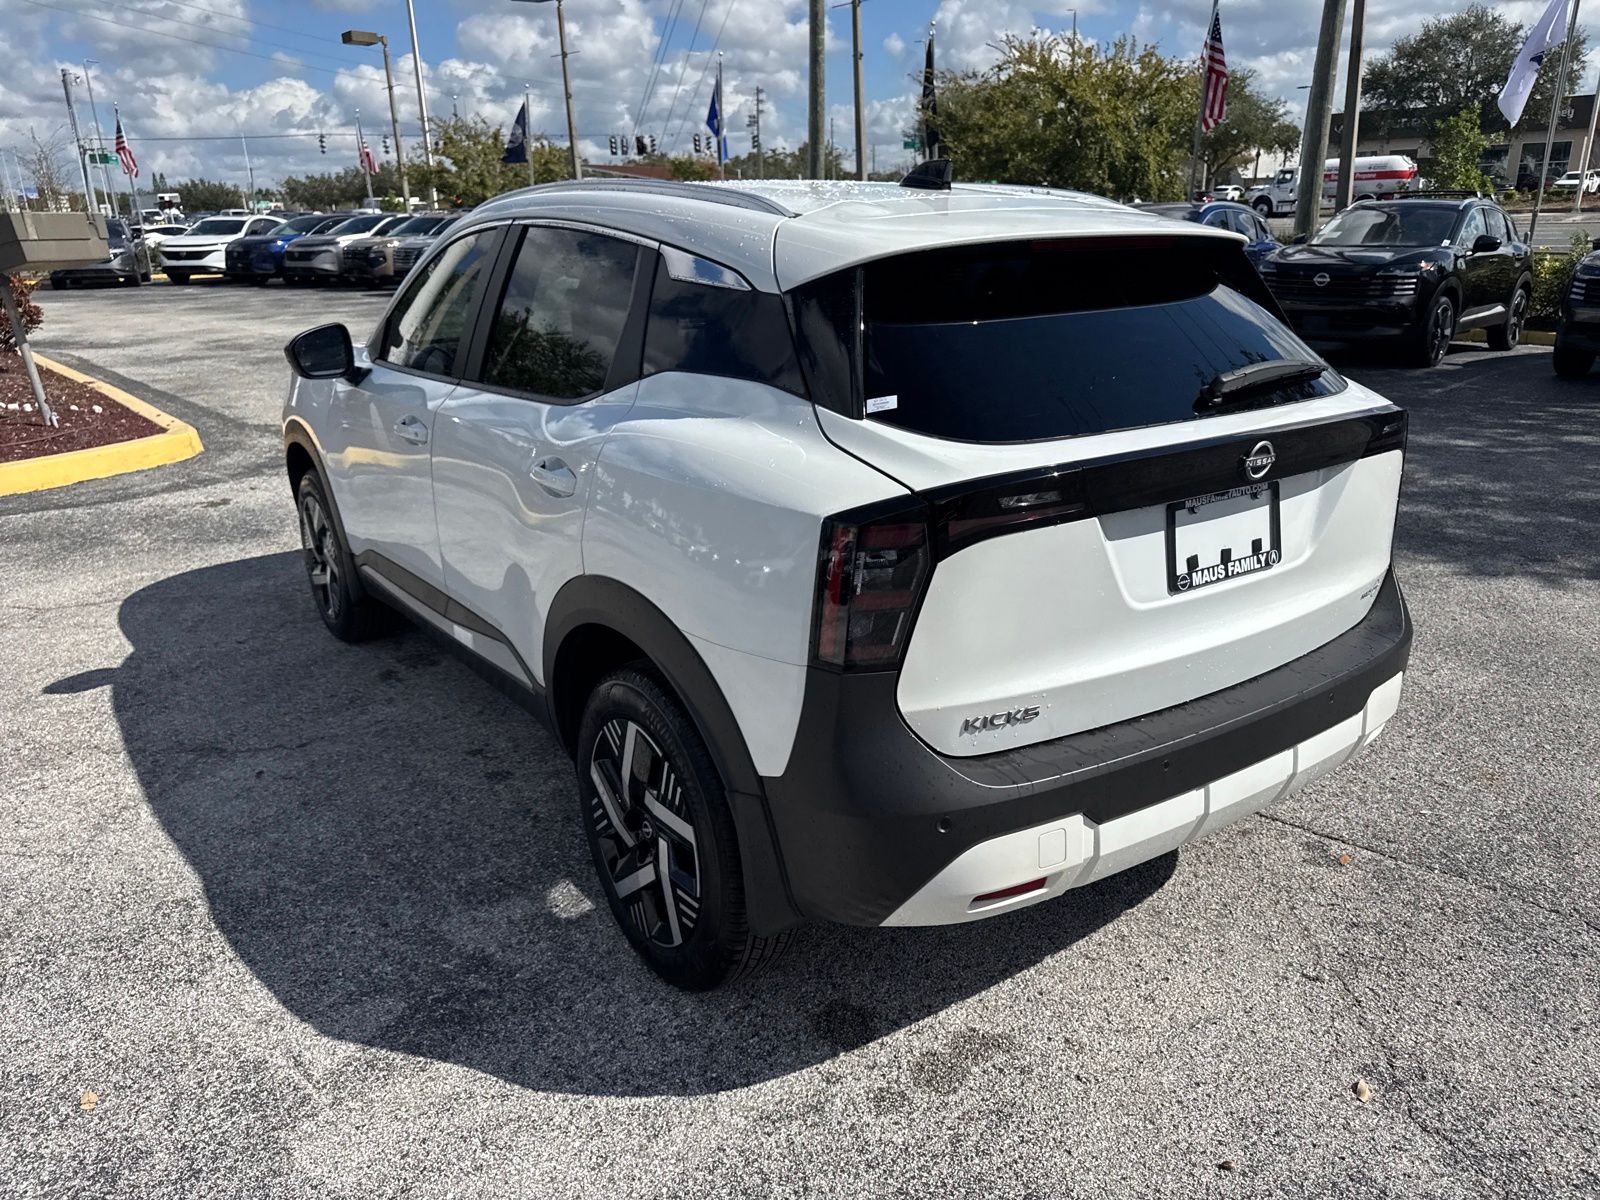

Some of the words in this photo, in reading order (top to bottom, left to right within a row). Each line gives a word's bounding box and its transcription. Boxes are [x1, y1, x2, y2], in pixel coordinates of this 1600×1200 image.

[1245, 456, 1276, 467] NISSAN
[1192, 564, 1226, 587] MAUS
[1228, 553, 1267, 576] FAMILY
[962, 704, 1041, 732] KICKS
